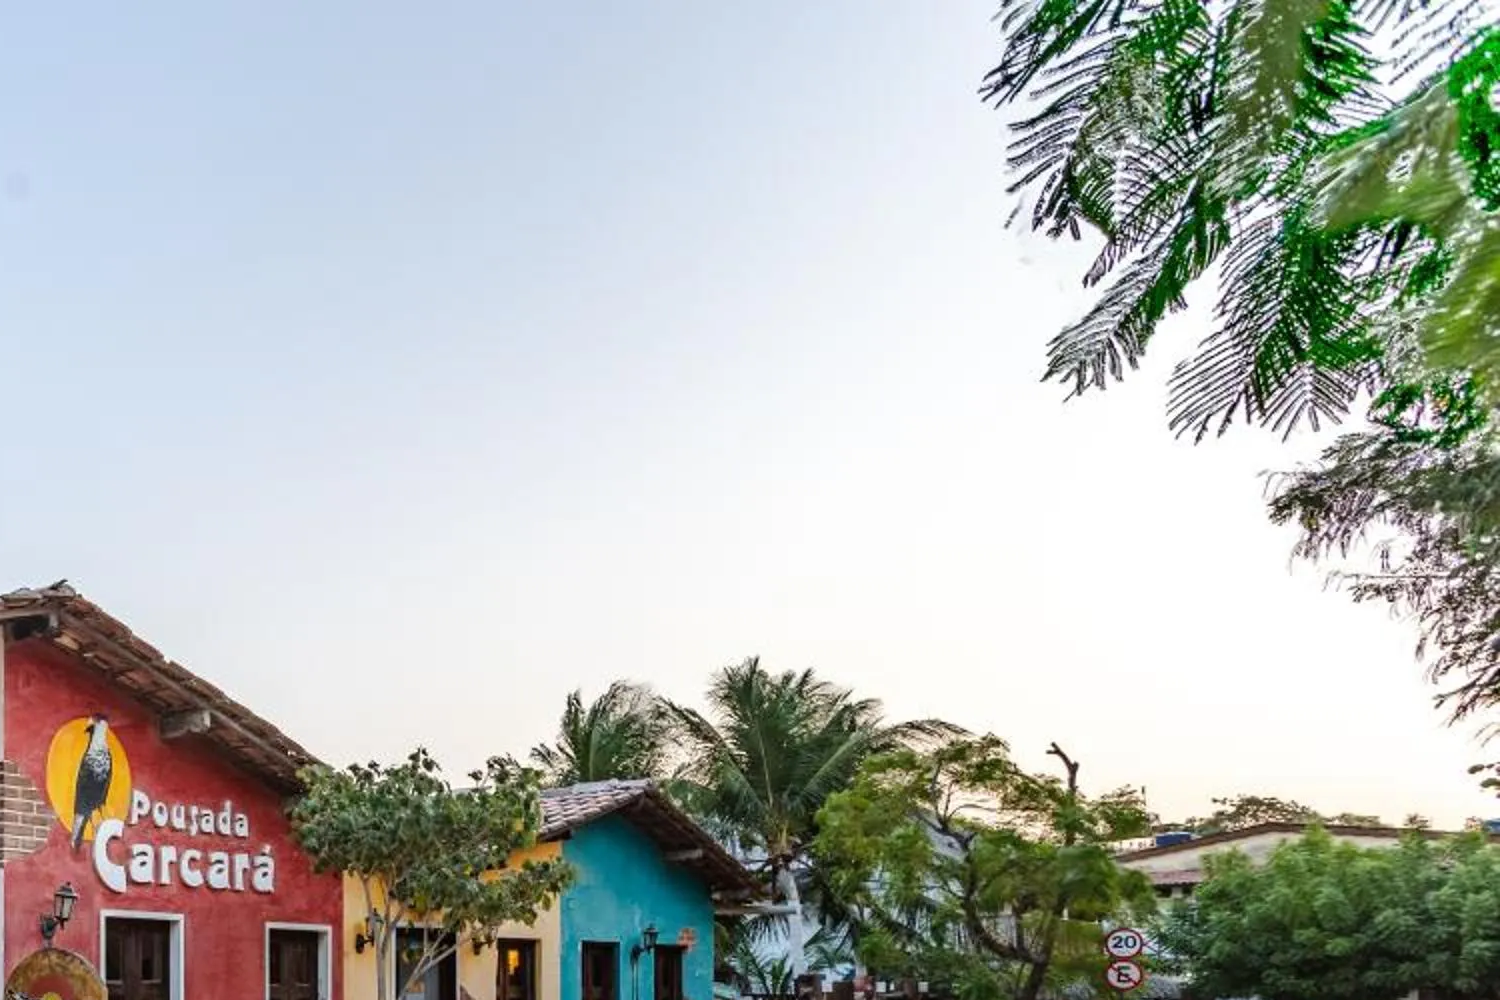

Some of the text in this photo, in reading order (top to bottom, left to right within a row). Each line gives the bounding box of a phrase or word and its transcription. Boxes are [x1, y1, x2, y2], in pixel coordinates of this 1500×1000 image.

[131, 789, 249, 838] Pousada
[94, 818, 276, 894] Carcará
[1112, 935, 1137, 949] 20
